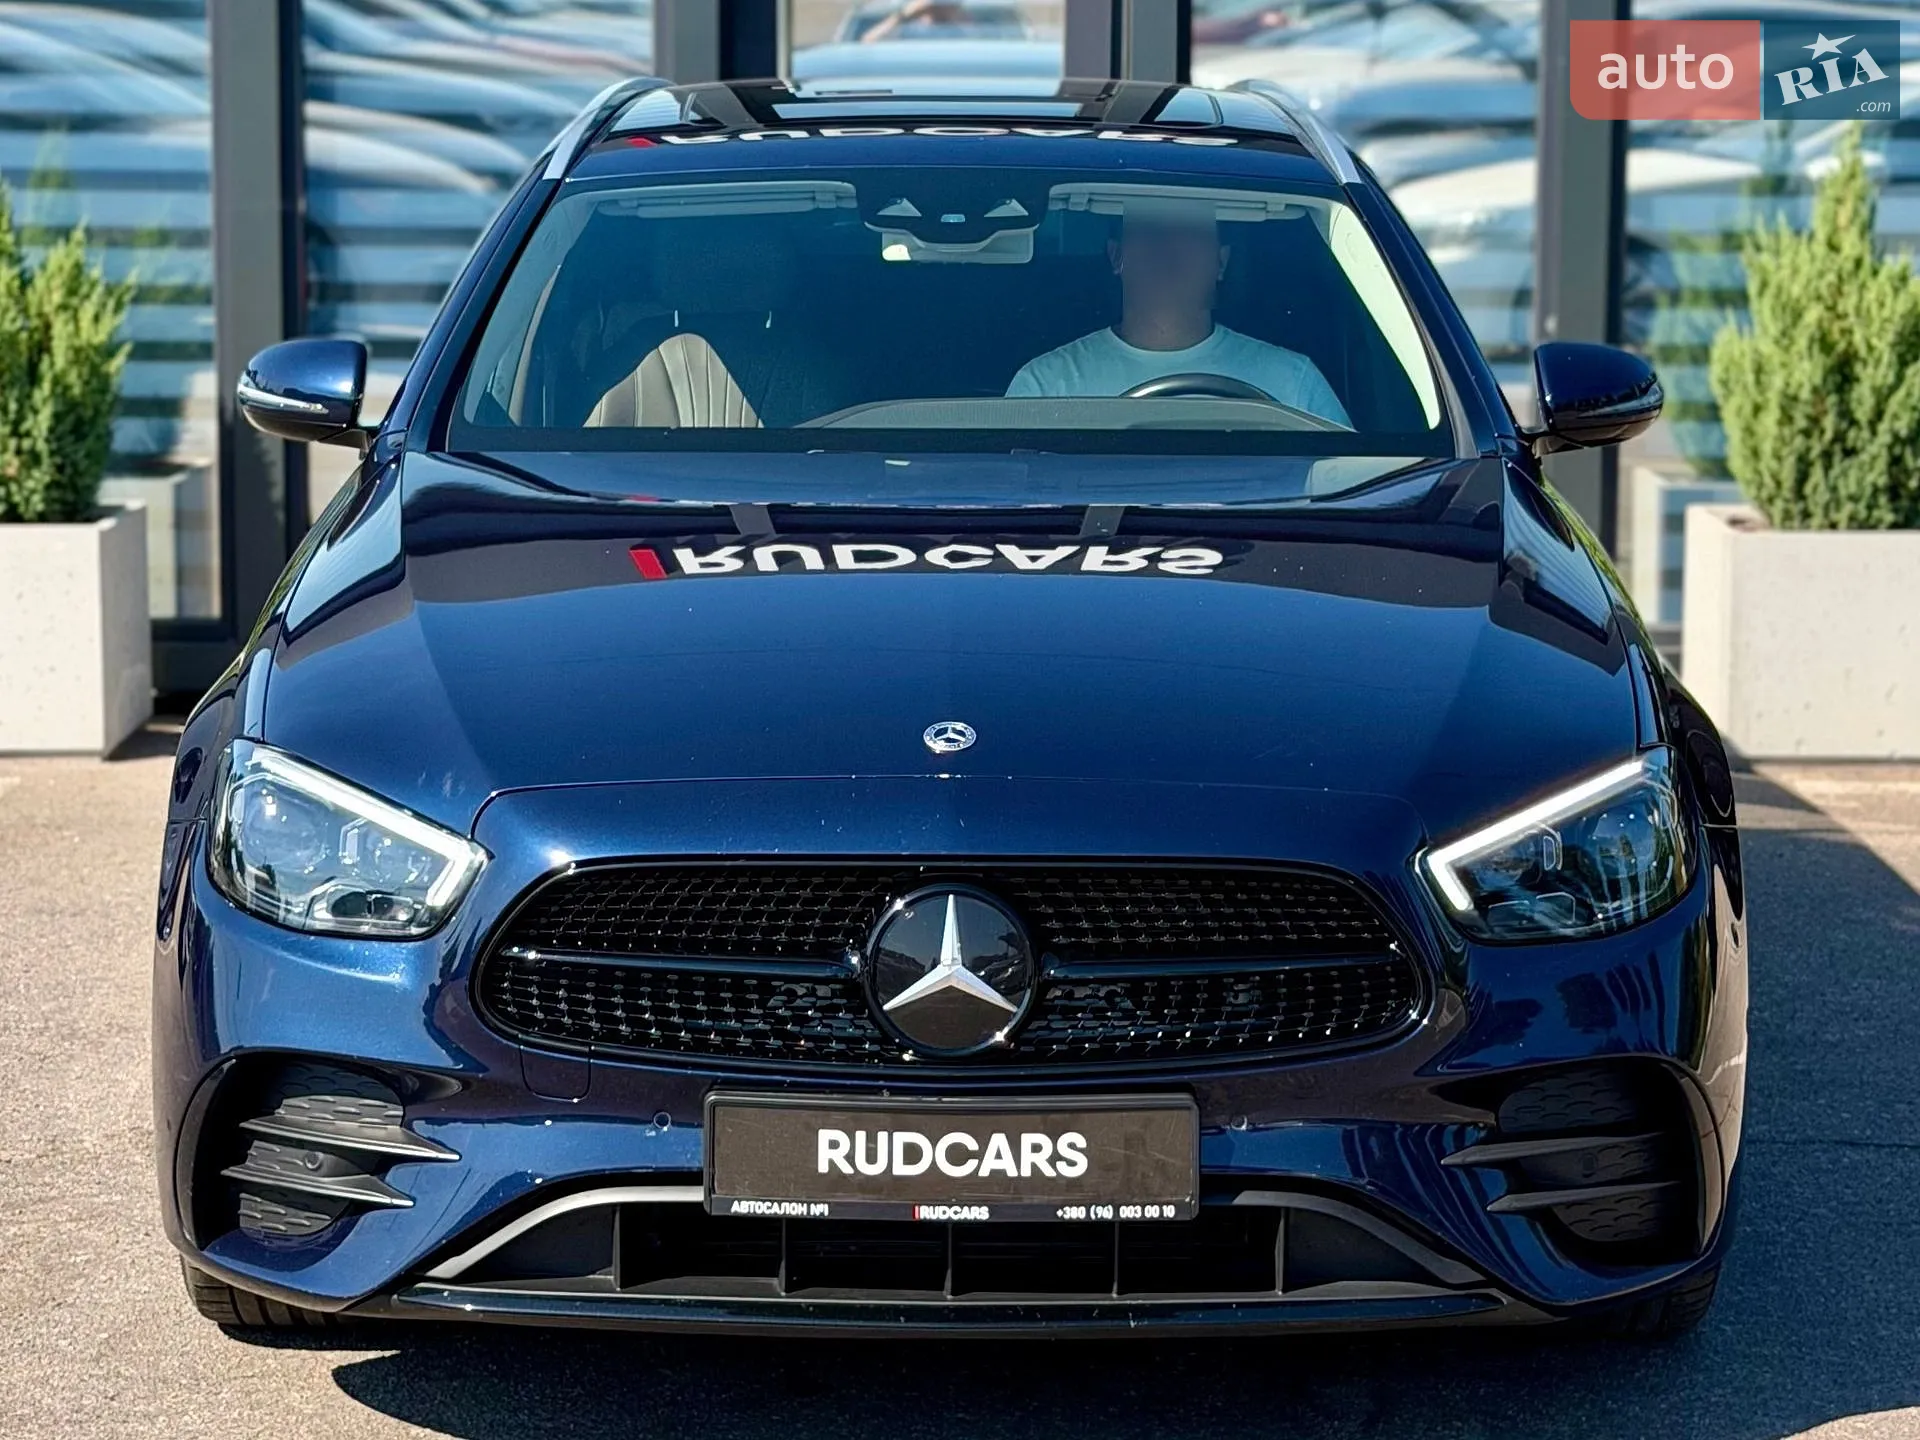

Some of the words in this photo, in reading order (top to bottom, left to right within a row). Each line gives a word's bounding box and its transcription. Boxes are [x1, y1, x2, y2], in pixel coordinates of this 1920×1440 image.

[817, 1128, 1089, 1178] RUDCARS
[731, 1199, 807, 1215] АВТОСАЛОН
[810, 1202, 830, 1217] №1
[919, 1205, 990, 1220] RUDCARS
[1056, 1205, 1087, 1219] +380
[1089, 1204, 1114, 1220] (96)
[1119, 1205, 1142, 1218] 003
[1144, 1204, 1160, 1218] 00
[1161, 1204, 1176, 1218] 10
